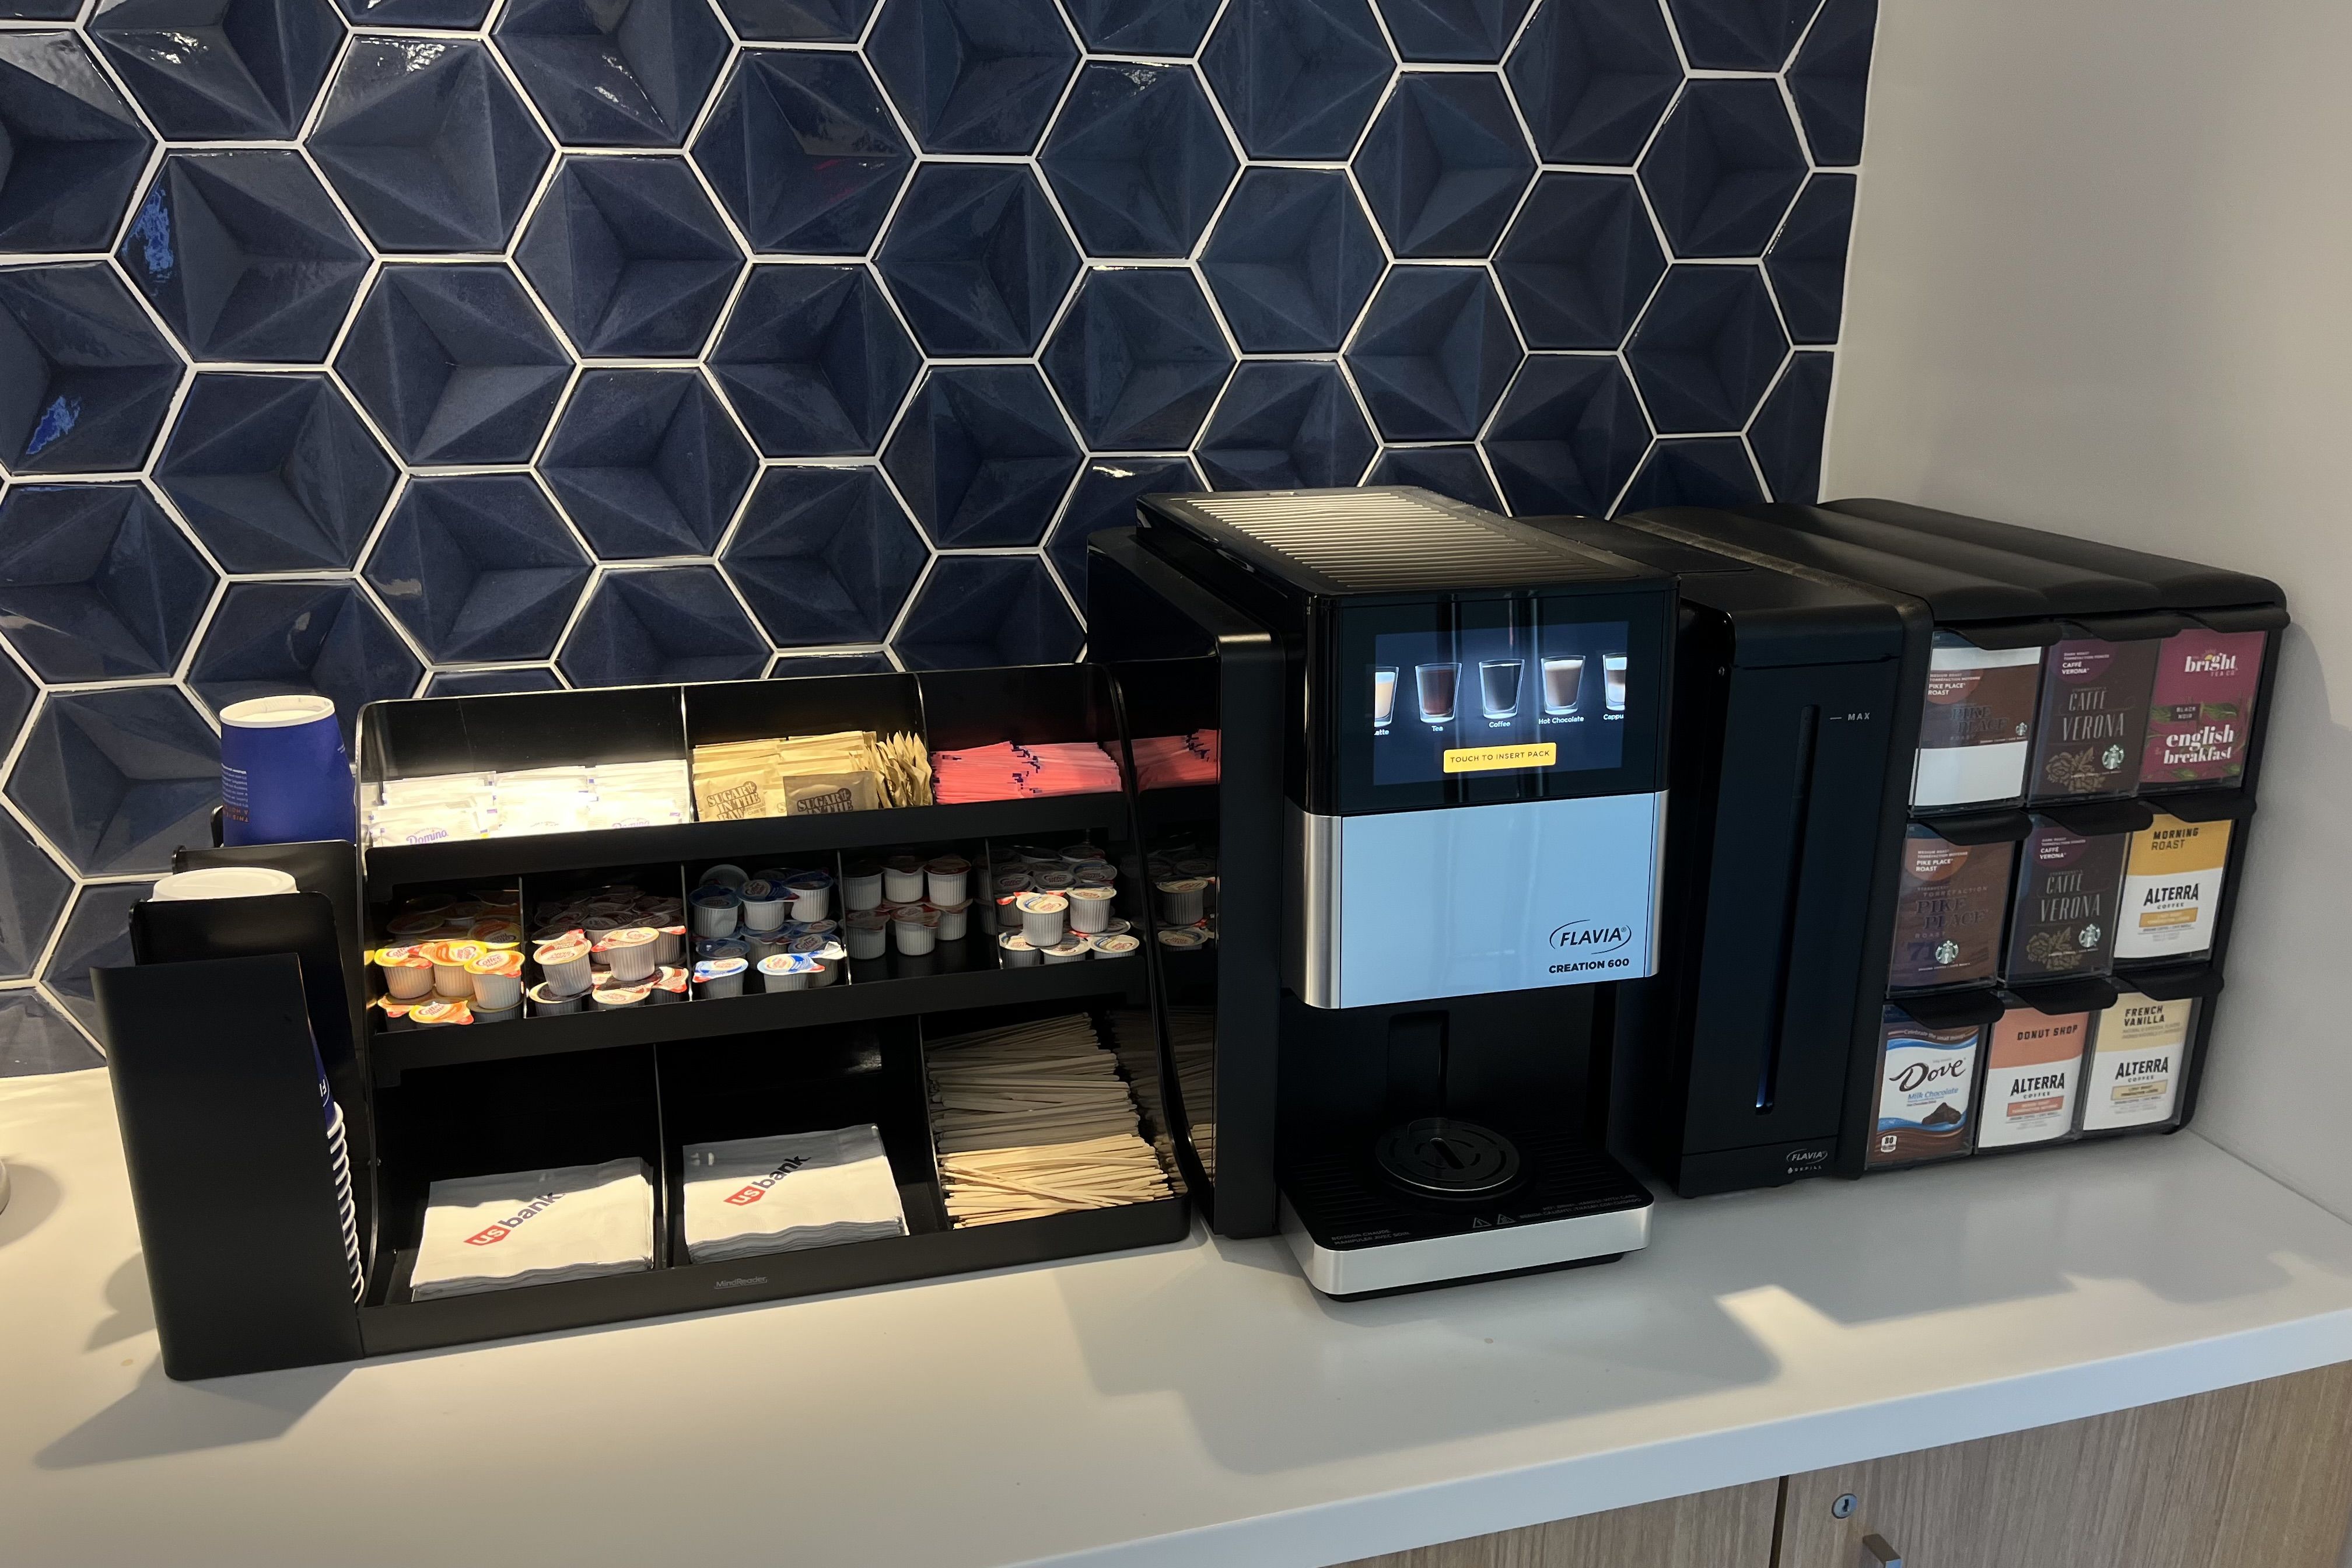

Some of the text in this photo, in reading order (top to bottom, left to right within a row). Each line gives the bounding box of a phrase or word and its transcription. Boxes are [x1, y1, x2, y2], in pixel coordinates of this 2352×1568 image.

[2185, 652, 2236, 672] bright
[1848, 712, 1870, 720] MAX
[2063, 713, 2124, 741] VERONA
[2166, 724, 2234, 751] english
[2164, 746, 2232, 764] breakfast
[707, 785, 748, 807] SUGAR
[718, 802, 733, 814] IN
[734, 792, 761, 808] THE
[797, 792, 842, 811] SUGAR
[824, 800, 853, 813] THE
[406, 829, 449, 845] Domino
[2153, 828, 2199, 840] MORNING
[2151, 839, 2185, 850] ROAST
[2143, 883, 2199, 906] ALTERRA
[1916, 897, 1966, 914] PIKE
[2041, 894, 2100, 922] VERONA
[1560, 928, 1622, 947] FLAVIA
[475, 955, 501, 967] Coffee
[1549, 958, 1630, 974] CREATION 600
[418, 1003, 442, 1015] Coffee
[2125, 1005, 2163, 1017] FRENCH
[2124, 1014, 2165, 1027] VANILLA
[2017, 1024, 2078, 1041] DONUT SHOP
[1889, 1059, 1966, 1092] Dove
[2115, 1056, 2168, 1080] ALTERRA
[1908, 1091, 1924, 1100] Milk
[1925, 1087, 1959, 1098] Chocolate
[2010, 1073, 2065, 1097] ALTERRA
[1791, 1151, 1822, 1161] FLAVIA
[716, 1276, 766, 1287] MindReader
